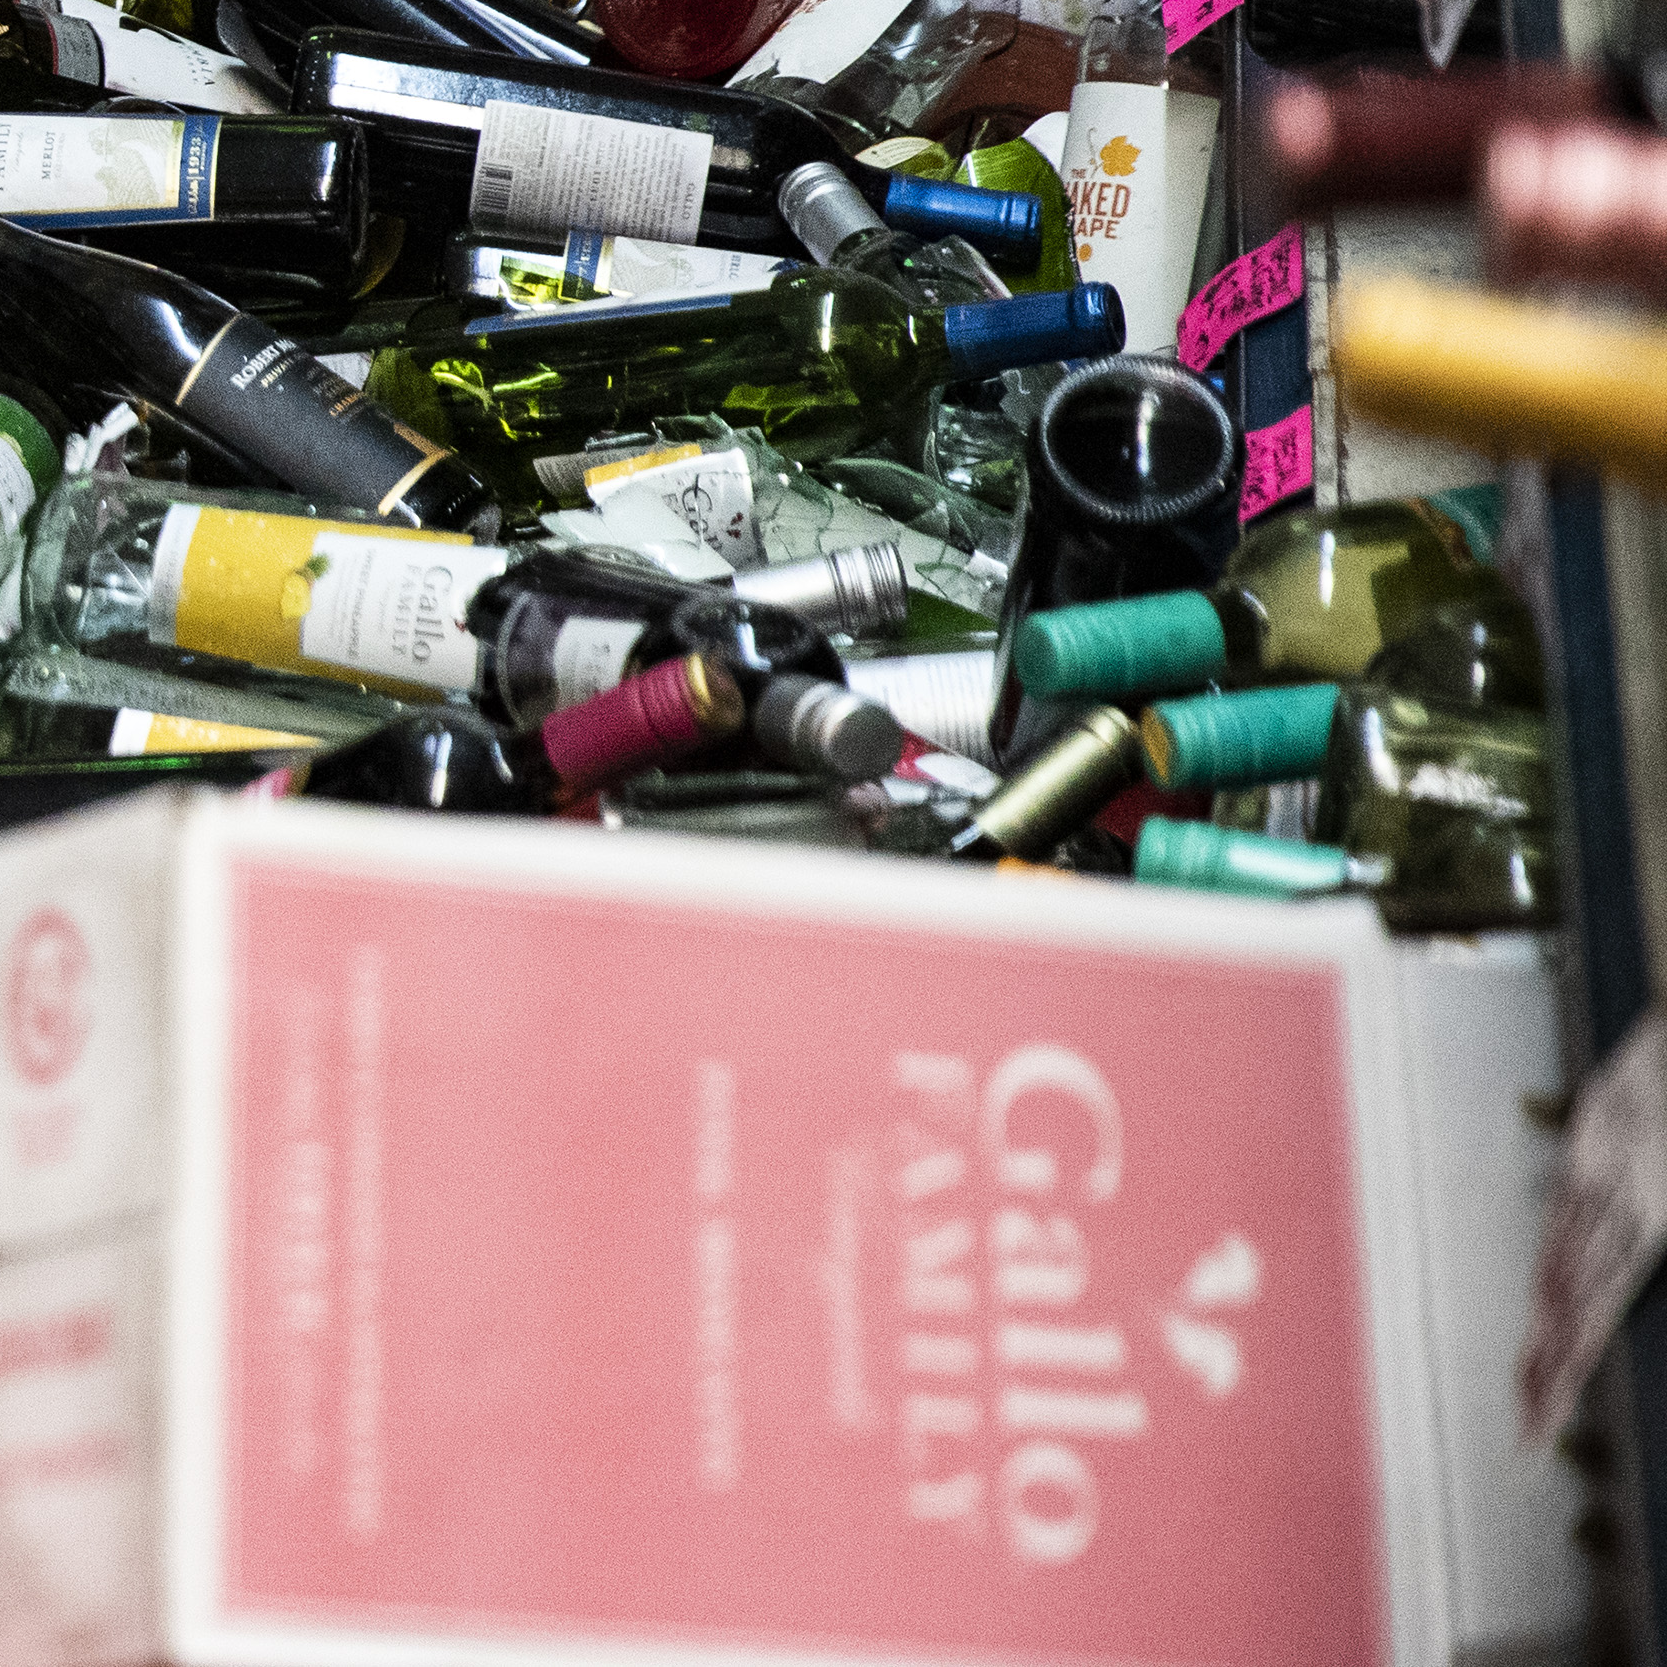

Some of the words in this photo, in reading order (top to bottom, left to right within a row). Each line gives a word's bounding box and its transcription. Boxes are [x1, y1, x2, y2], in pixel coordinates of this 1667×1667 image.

[41, 131, 56, 180] MERLOT
[682, 183, 698, 221] GALLO
[1069, 182, 1131, 217] AKED
[1076, 218, 1119, 239] APE
[392, 564, 422, 655] FAMILY
[411, 566, 453, 662] Gallo
[887, 1047, 988, 1543] FAMILY
[980, 1041, 1151, 1566] Gallo
